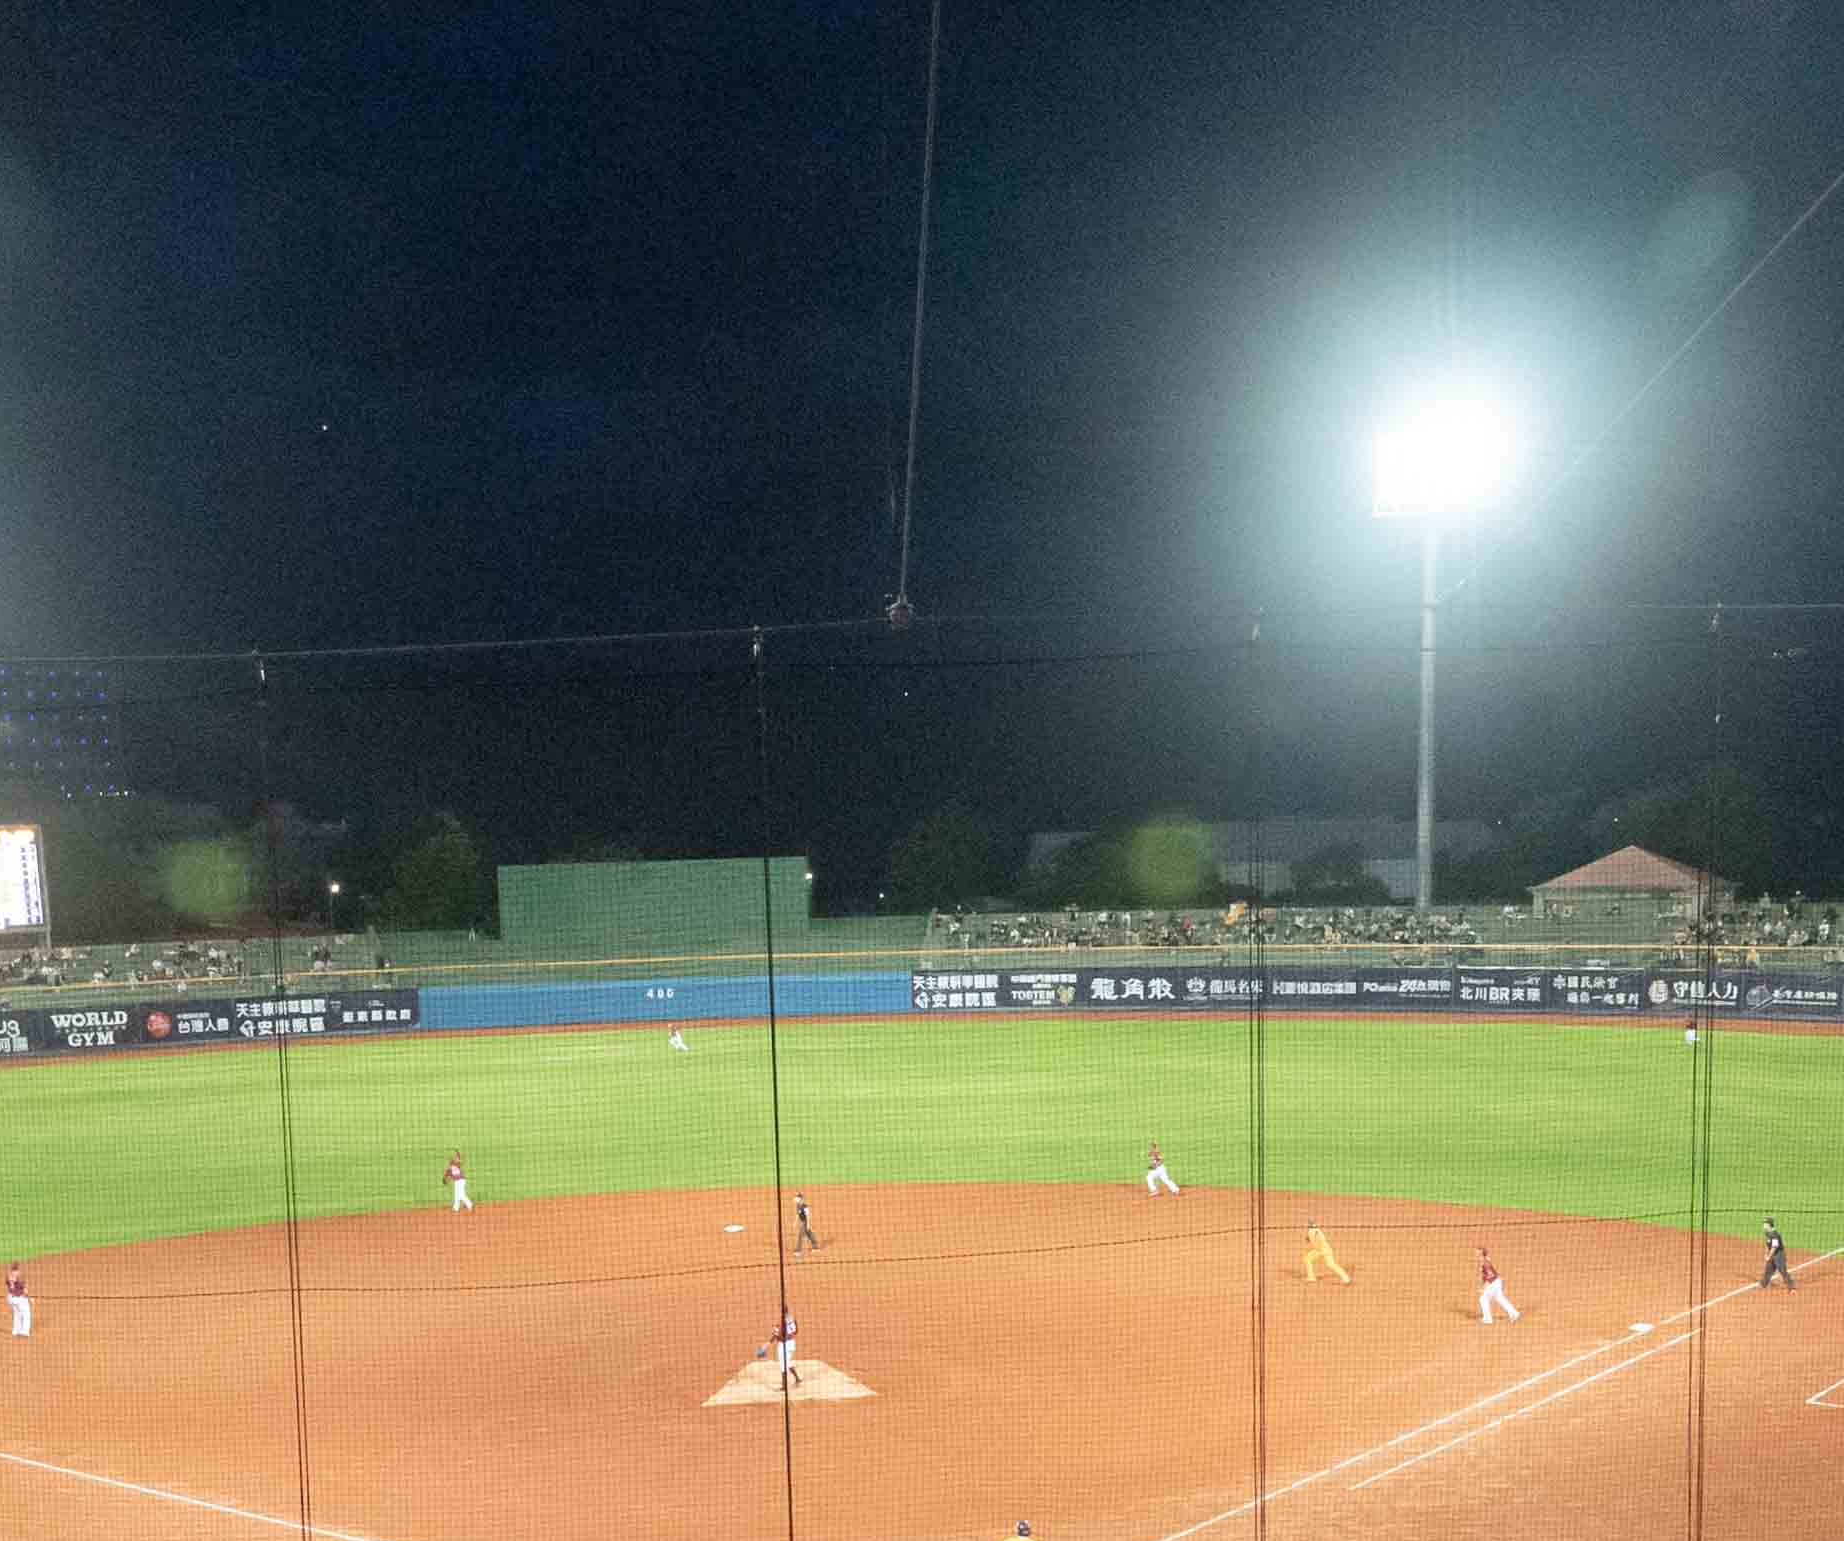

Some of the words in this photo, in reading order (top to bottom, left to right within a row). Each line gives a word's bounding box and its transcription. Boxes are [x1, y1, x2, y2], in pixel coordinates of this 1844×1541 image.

[1090, 977, 1176, 1000] 龍角散
[51, 1010, 129, 1029] WORLD
[67, 1031, 116, 1048] GYM
